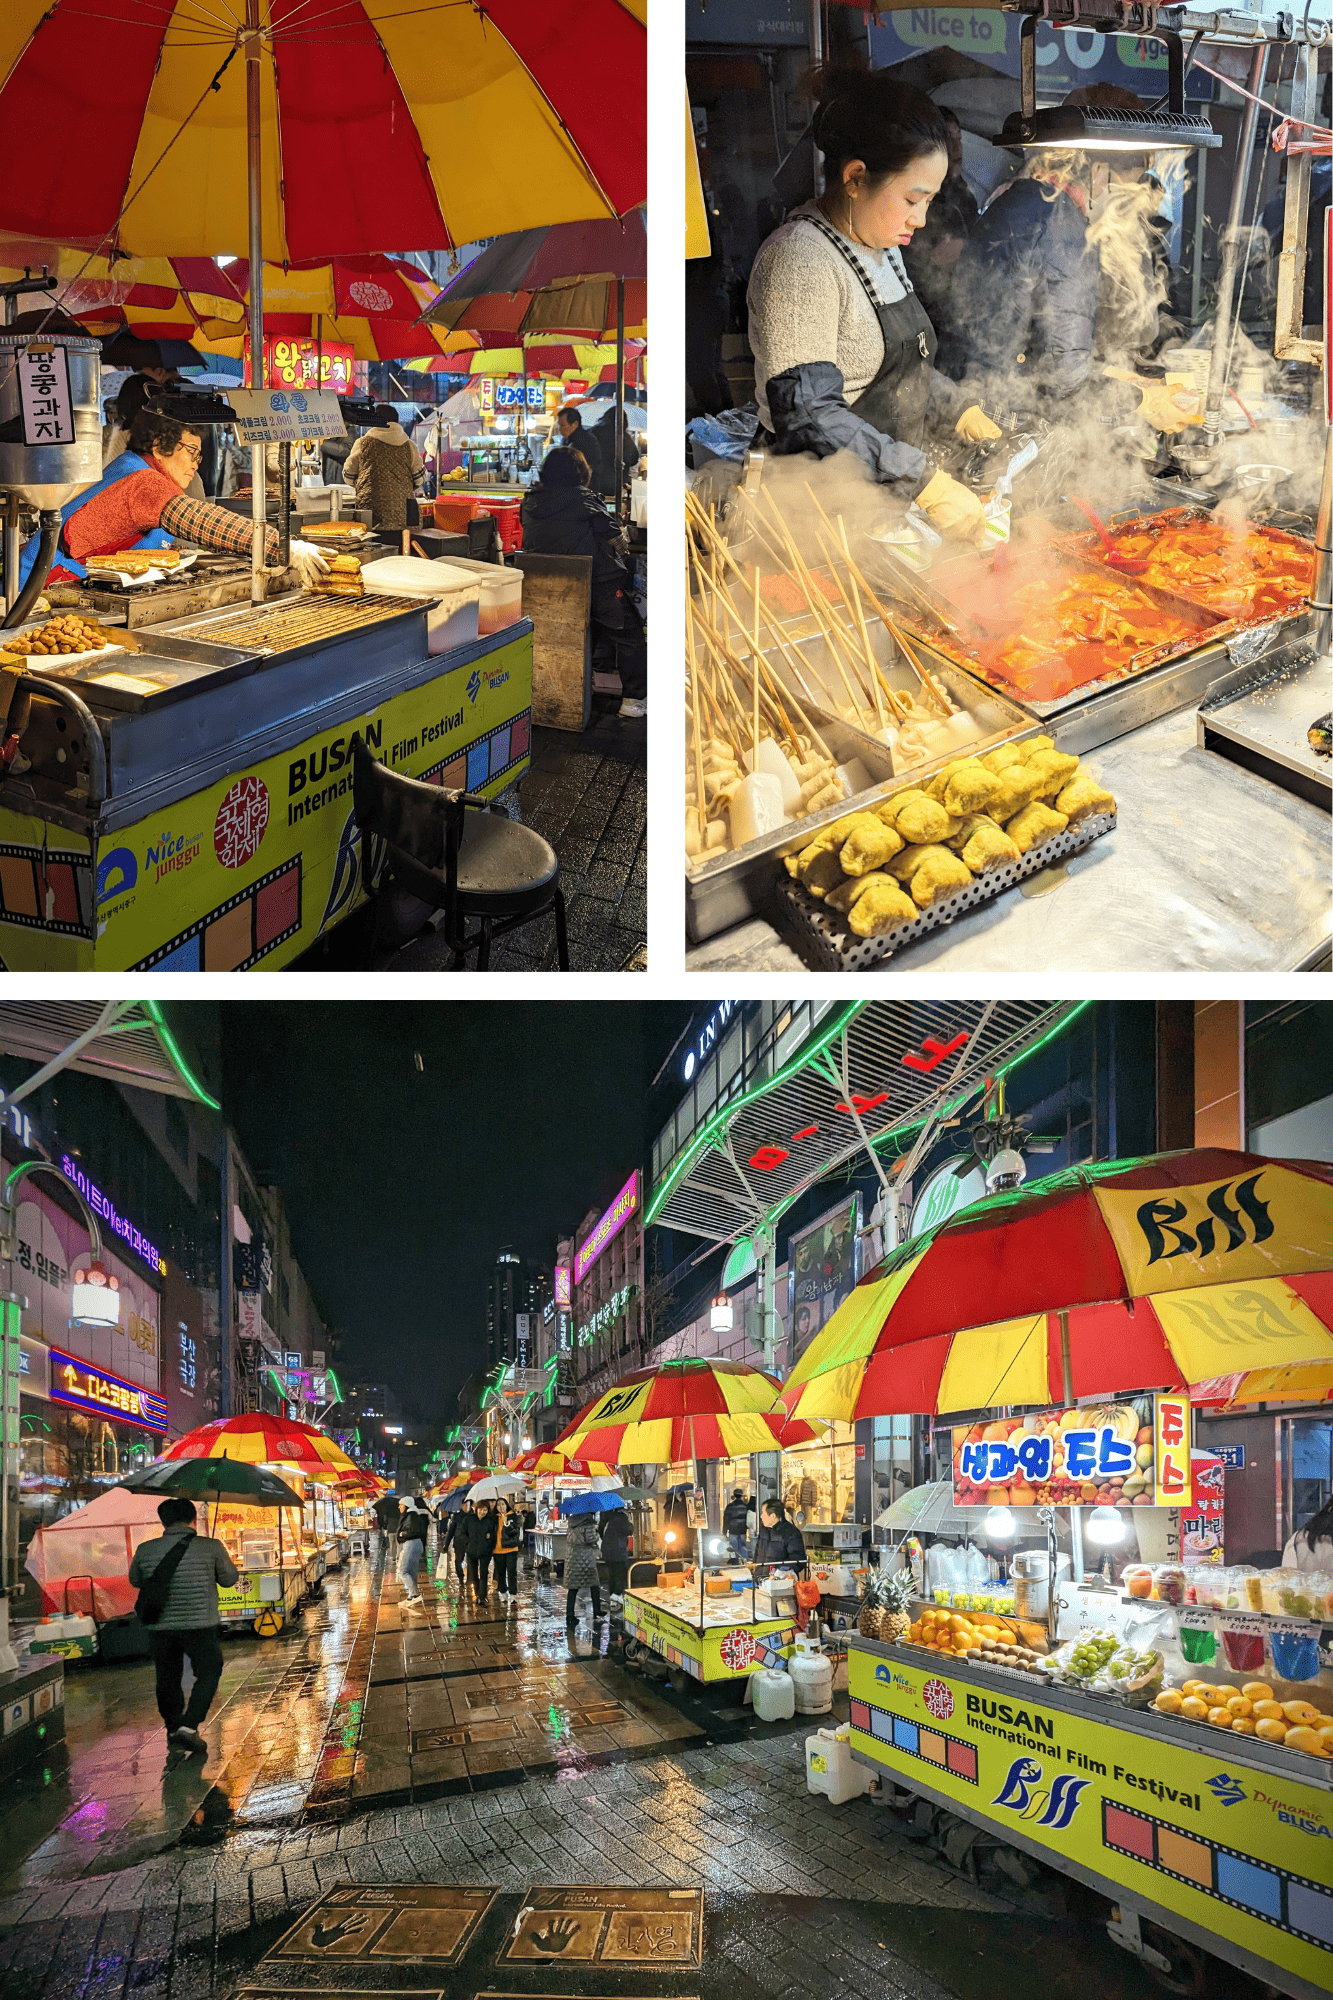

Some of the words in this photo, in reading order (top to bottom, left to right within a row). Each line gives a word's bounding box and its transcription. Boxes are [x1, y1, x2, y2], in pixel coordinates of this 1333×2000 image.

[910, 9, 964, 38] Nice
[968, 15, 993, 41] to
[27, 351, 63, 439] 땅콩과자
[489, 671, 510, 690] BUSAN
[392, 736, 418, 766] Film
[421, 707, 464, 748] Festival
[288, 718, 382, 797] BUSAN
[144, 834, 185, 871] Nice
[97, 895, 137, 922] 산광역시중구
[782, 1459, 804, 1469] ARANCE
[1063, 1428, 1134, 1480] 쥬스
[1158, 1402, 1186, 1497] 쥬스
[811, 1564, 834, 1574] Sunkist
[893, 1674, 909, 1687] Nice
[966, 1692, 1055, 1741] BUSAN
[966, 1716, 1062, 1760] International
[1066, 1748, 1107, 1777] Film
[1113, 1765, 1202, 1813] Festival
[1253, 1789, 1325, 1822] Dynamic
[1278, 1810, 1333, 1841] BUSA
[564, 1896, 599, 1904] PUSAN
